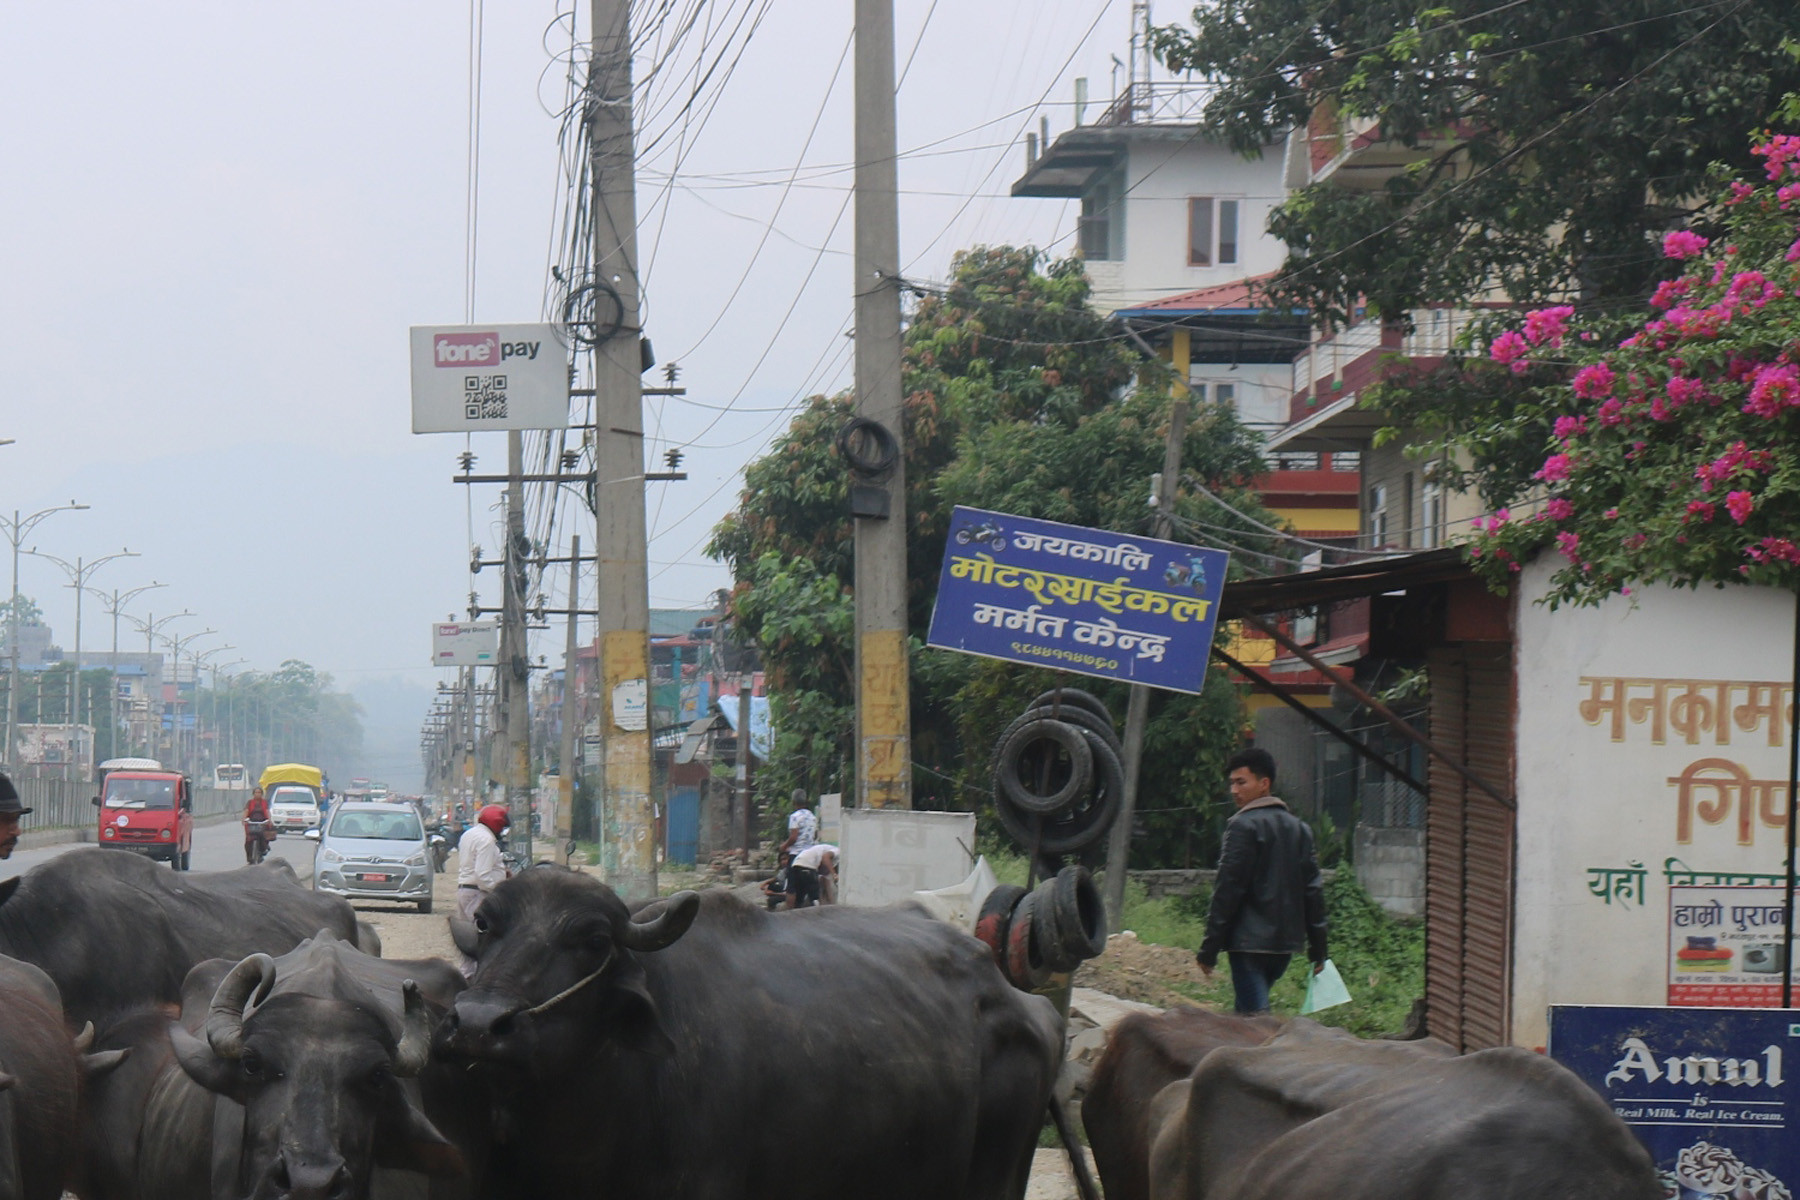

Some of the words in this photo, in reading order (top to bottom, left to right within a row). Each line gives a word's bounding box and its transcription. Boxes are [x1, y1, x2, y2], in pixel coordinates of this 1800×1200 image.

[1013, 530, 1154, 571] जयकालि
[972, 604, 1069, 638] मर्मत
[1072, 616, 1172, 662] केन्द्र
[1579, 676, 1794, 747] मनकाम
[1675, 899, 1723, 928] हाम्रो
[1605, 1037, 1785, 1088] Amul
[1646, 1107, 1680, 1118] Milk.
[1684, 1109, 1713, 1120] Real
[1717, 1109, 1737, 1120] Ice
[1741, 1109, 1785, 1121] Cream.
[1690, 1091, 1709, 1106] is
